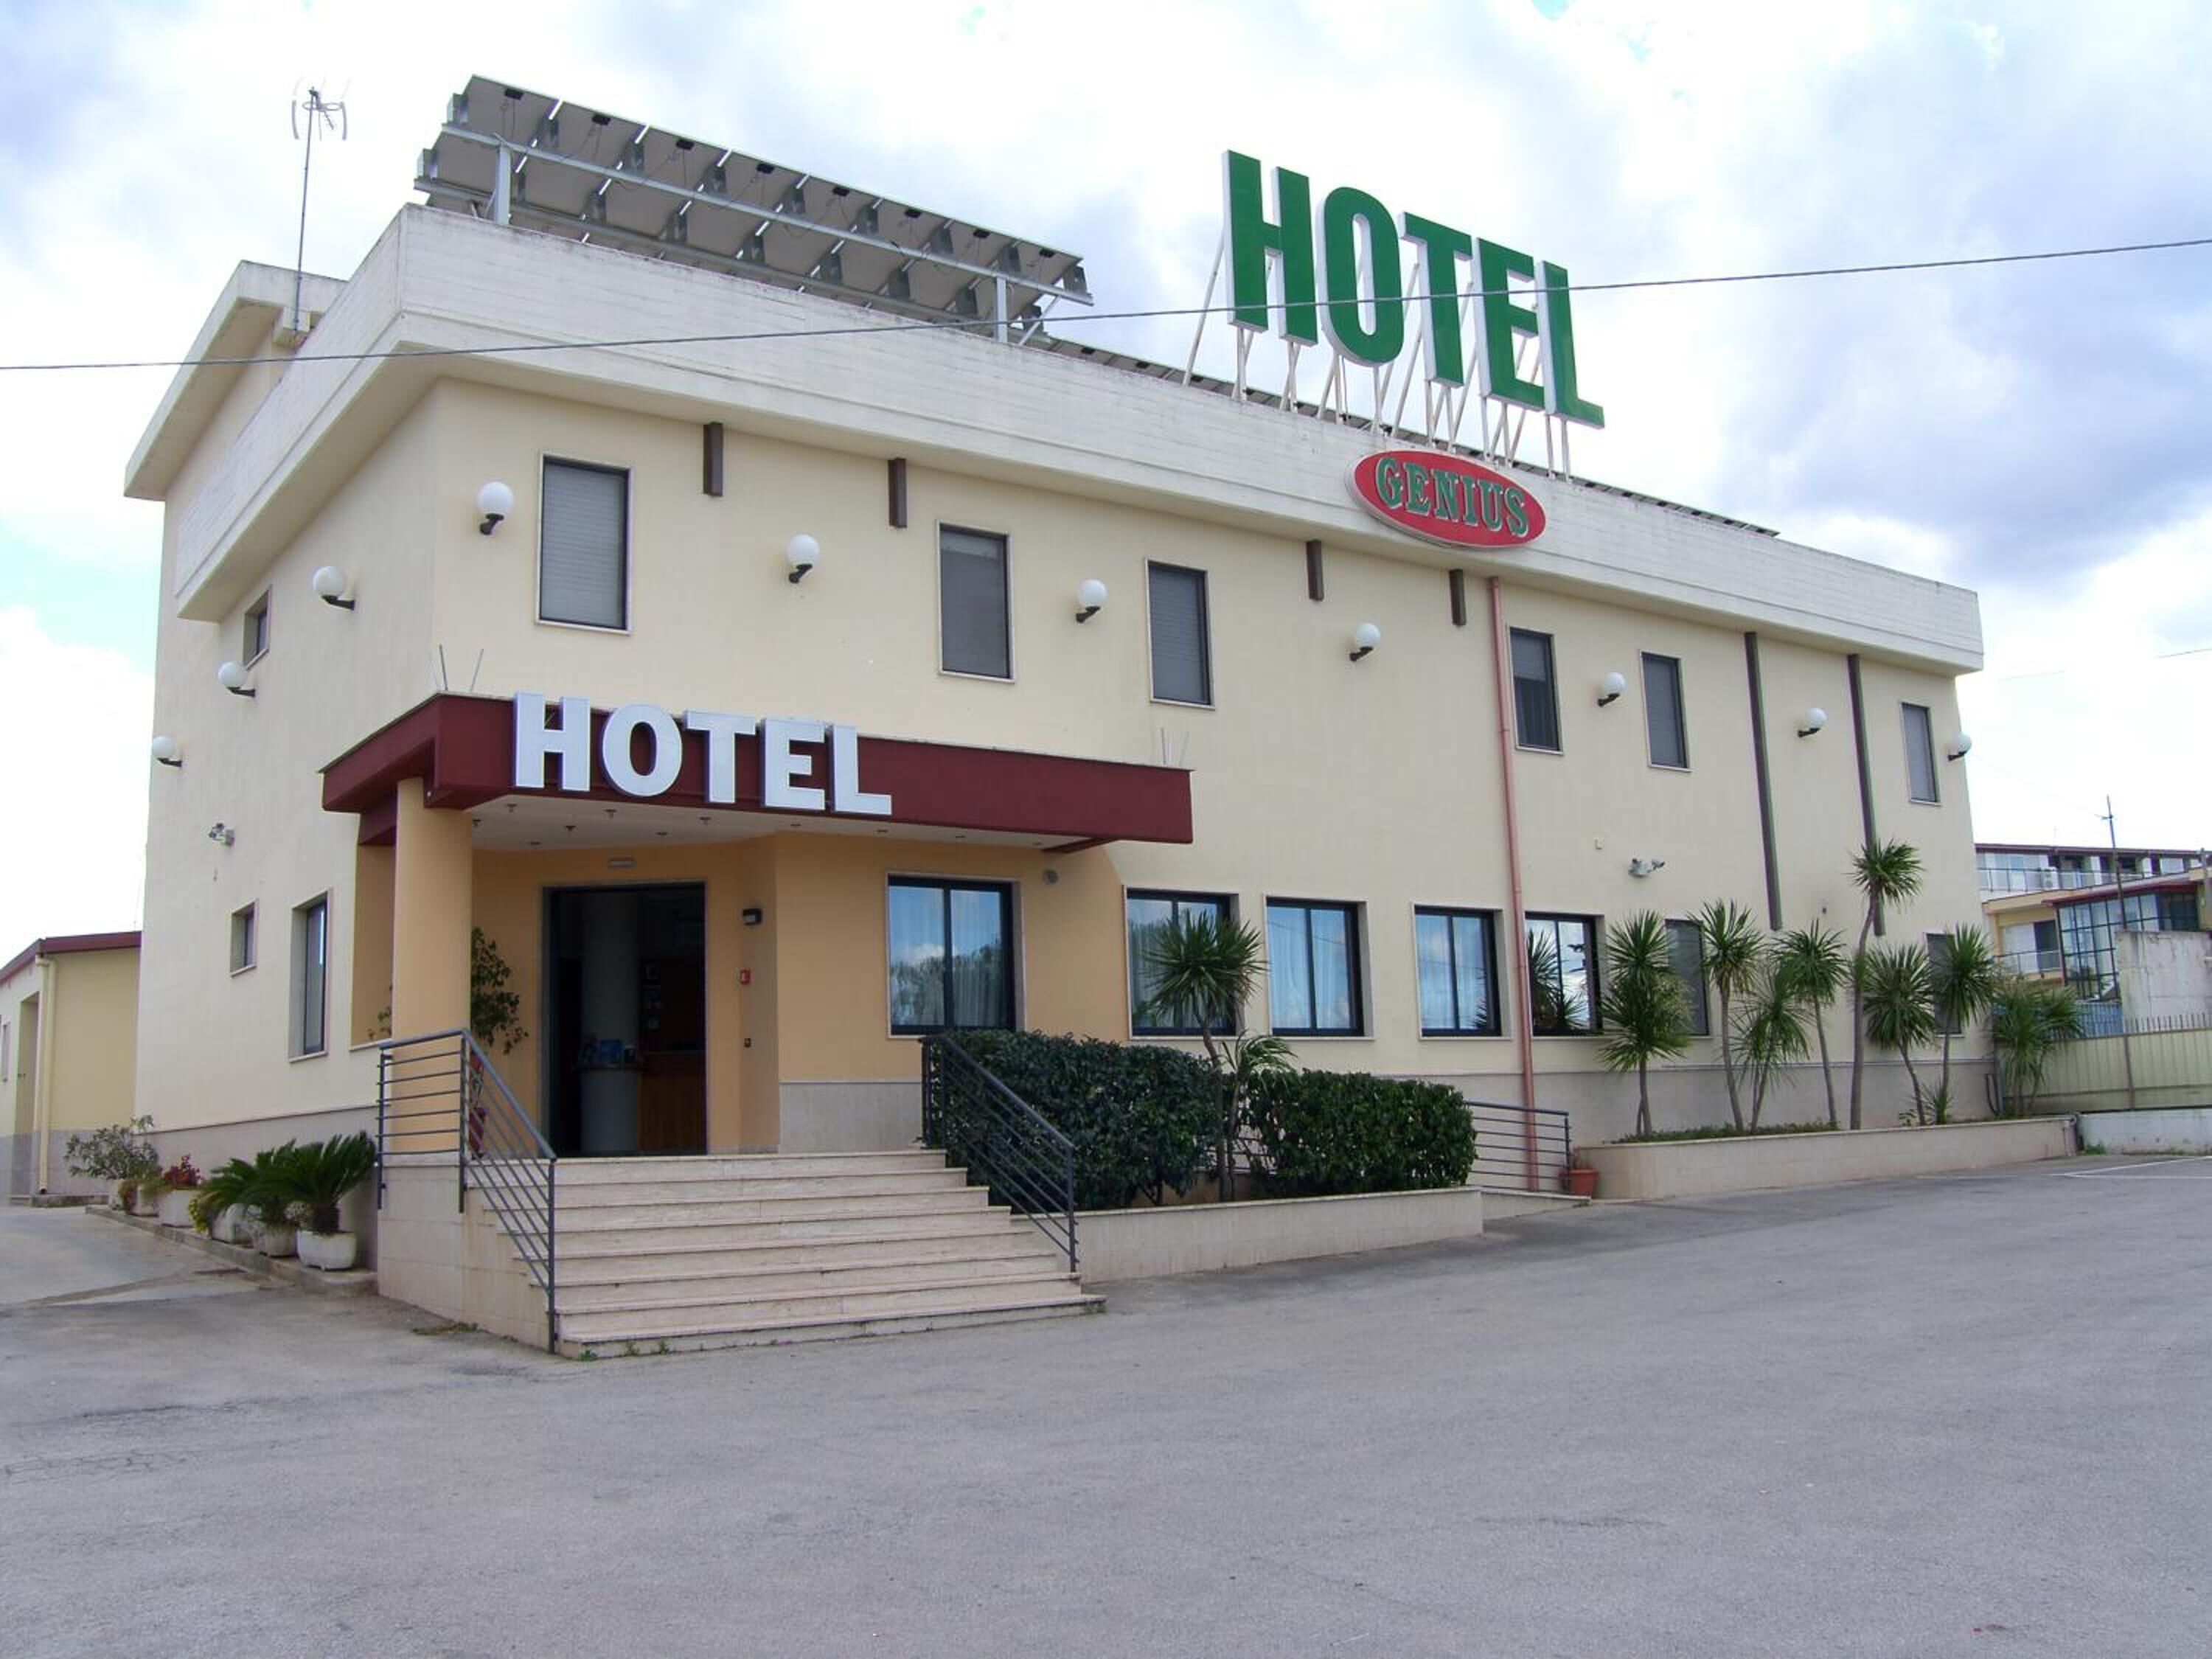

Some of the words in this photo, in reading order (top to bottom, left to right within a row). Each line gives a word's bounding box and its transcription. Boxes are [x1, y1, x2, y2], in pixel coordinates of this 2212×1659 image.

[1222, 150, 1605, 428] HOTEL
[1375, 456, 1530, 538] GENIUS
[514, 691, 892, 815] HOTEL
